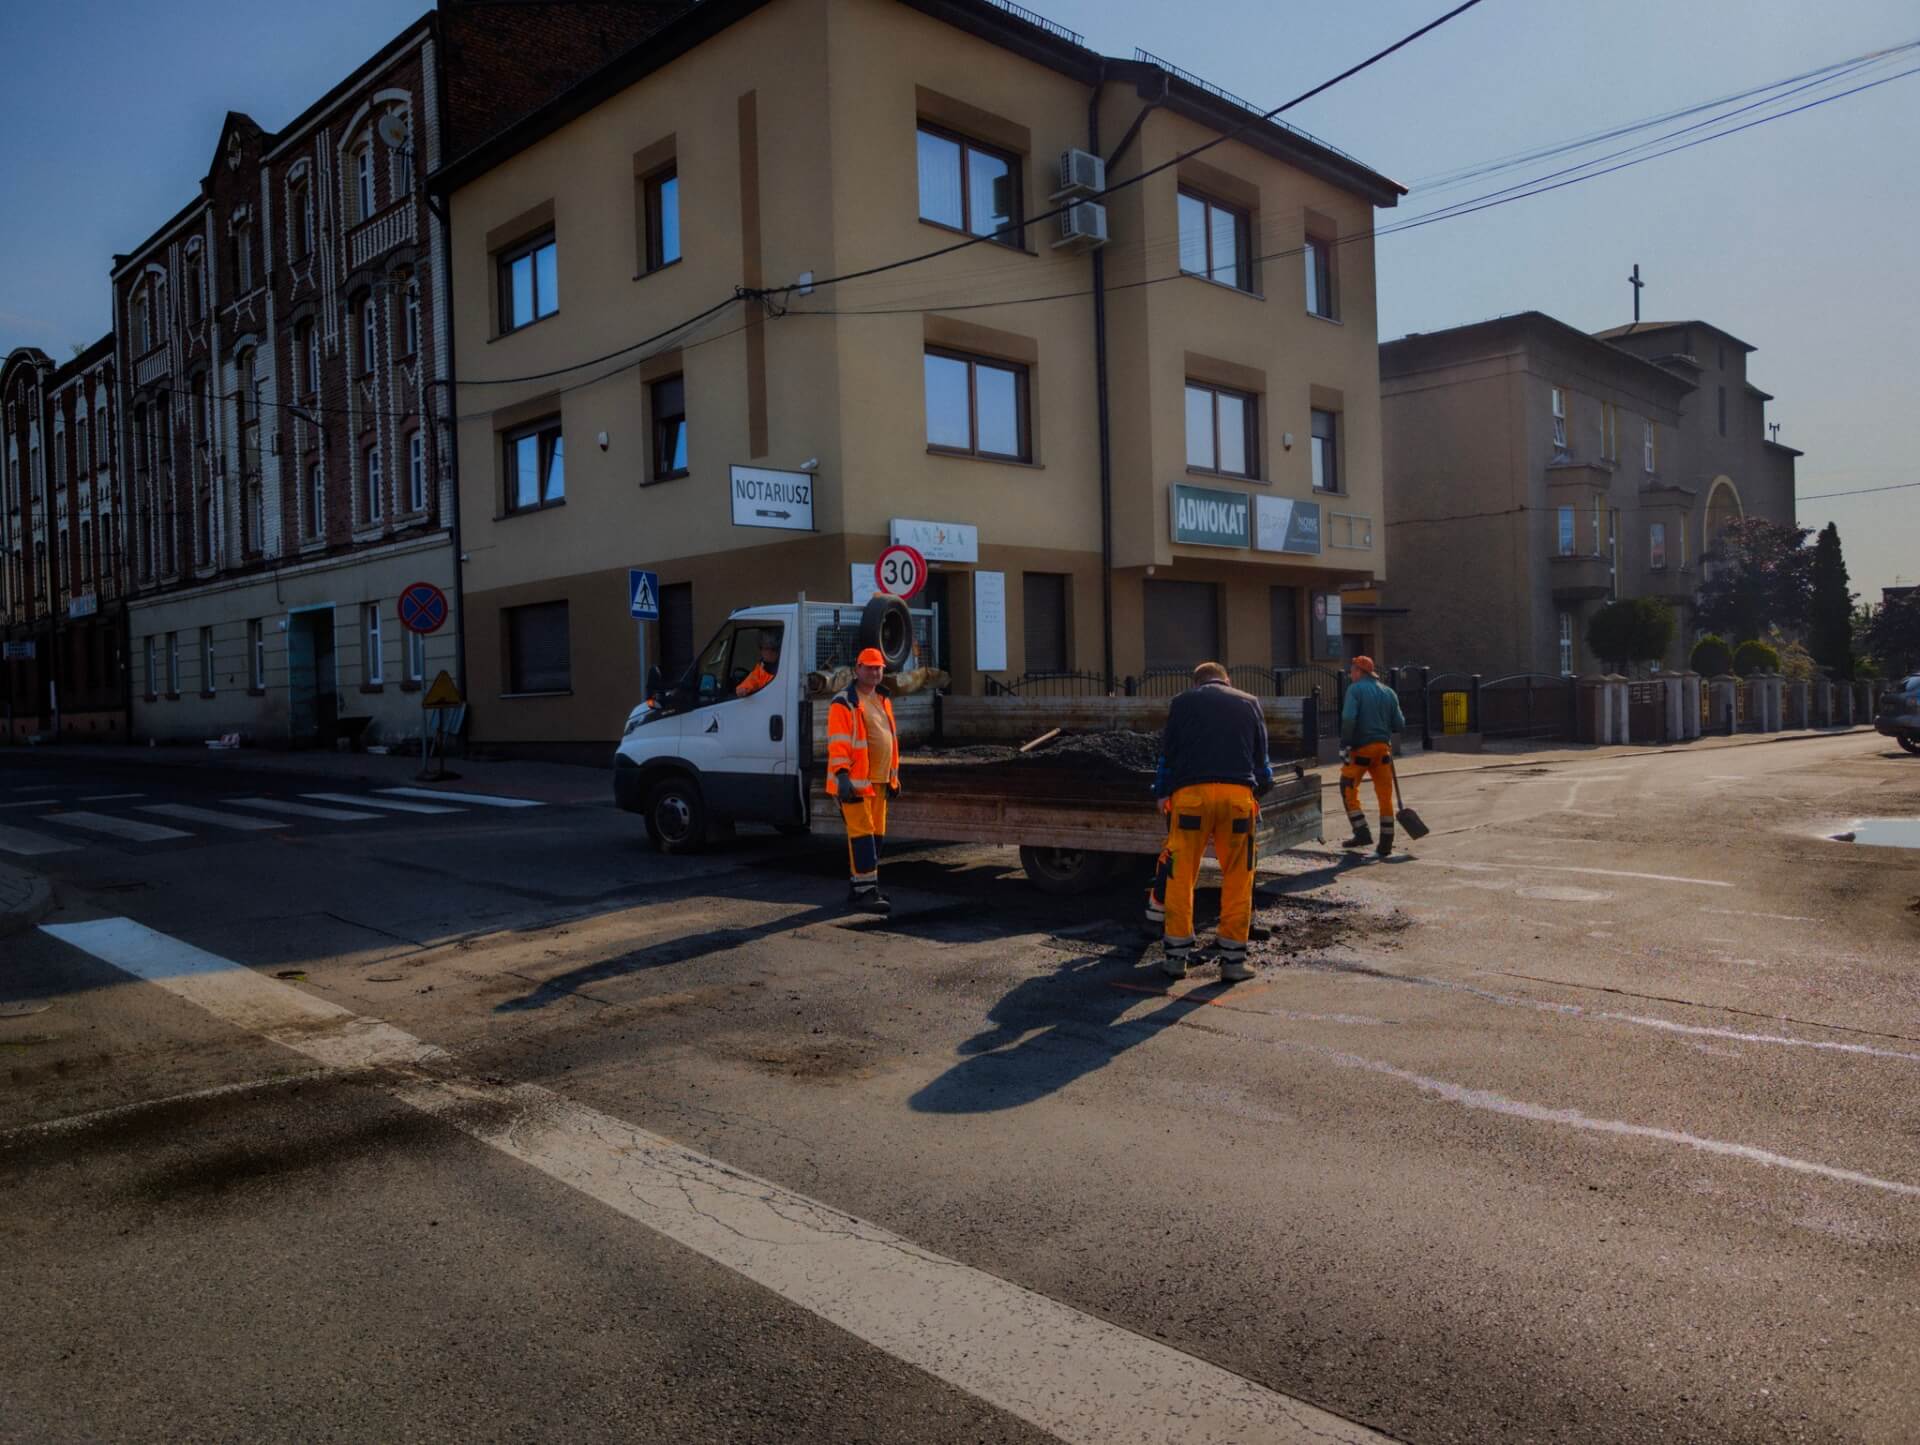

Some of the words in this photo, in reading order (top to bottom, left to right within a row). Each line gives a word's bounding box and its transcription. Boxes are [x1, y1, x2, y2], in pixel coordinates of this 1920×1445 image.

[736, 480, 809, 504] NOTARIUSZ
[1178, 497, 1247, 536] ADWOKAT
[884, 560, 914, 585] 30
